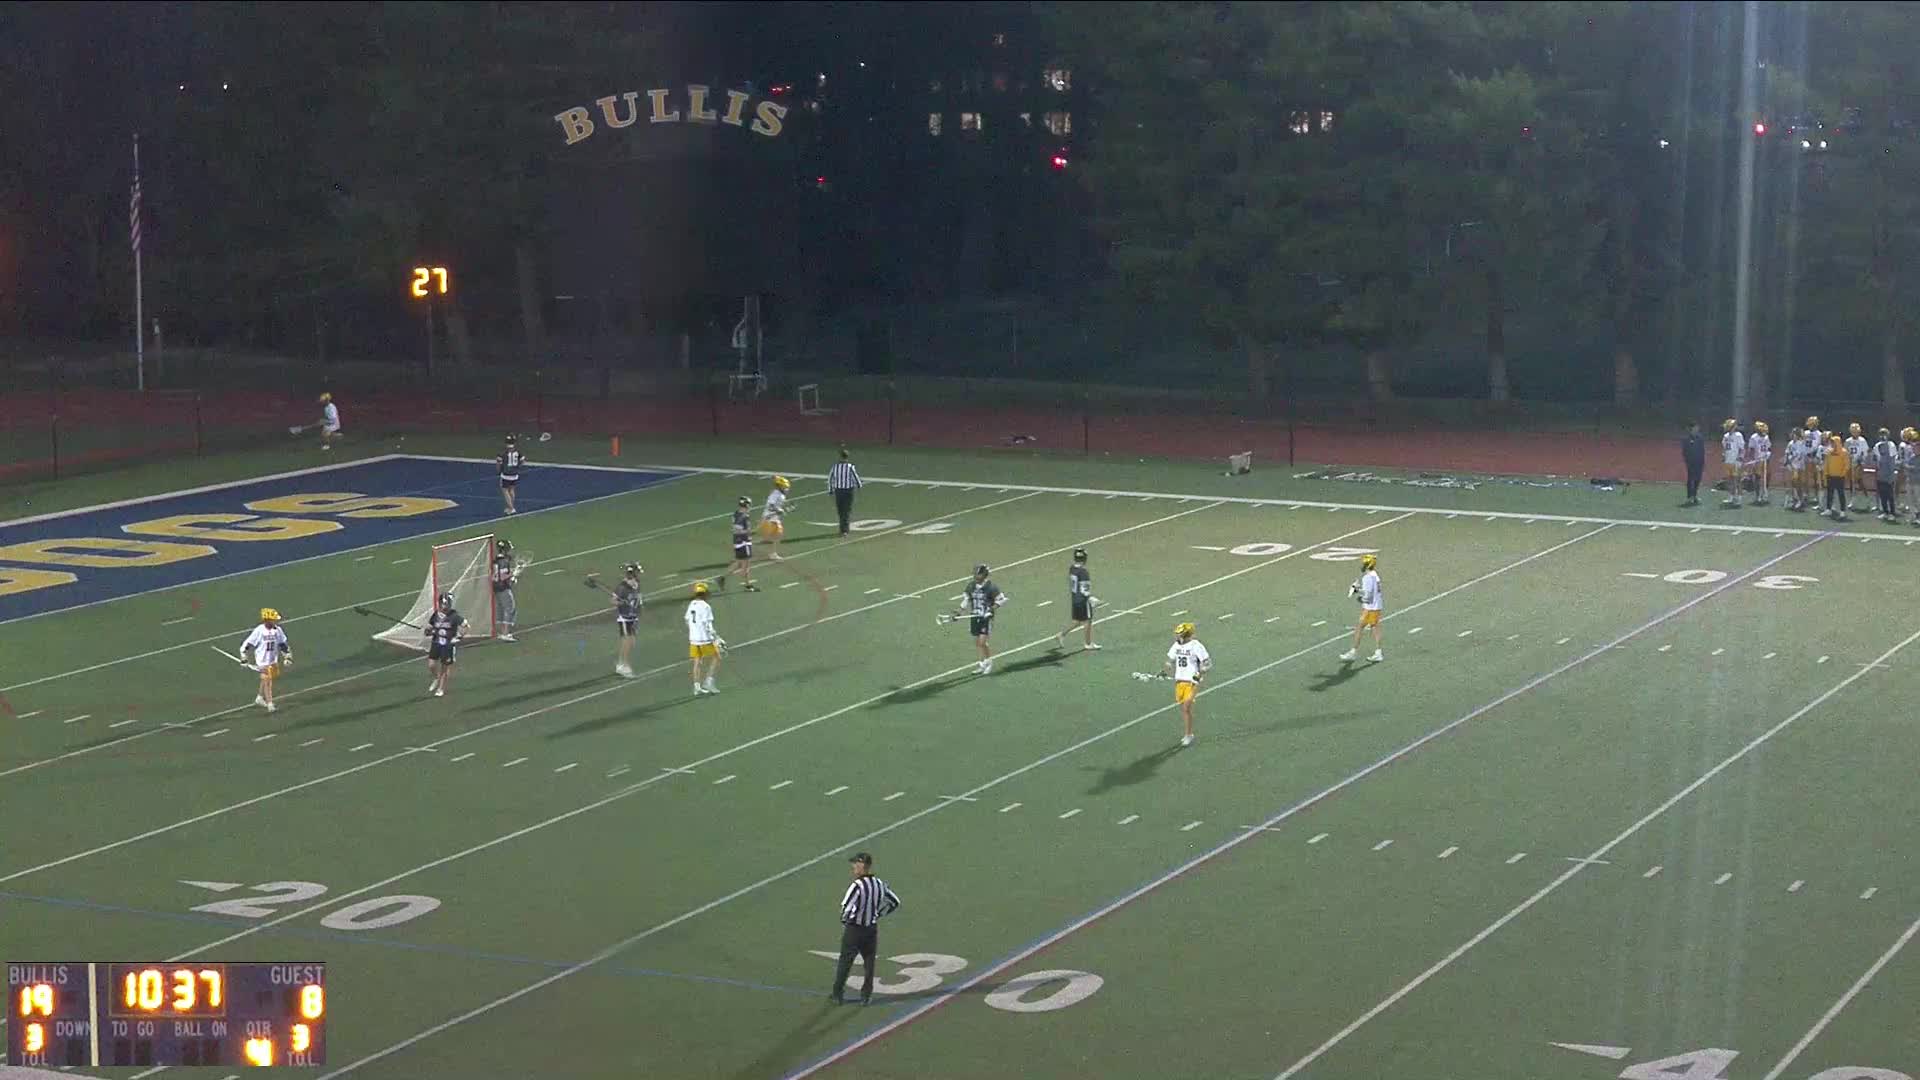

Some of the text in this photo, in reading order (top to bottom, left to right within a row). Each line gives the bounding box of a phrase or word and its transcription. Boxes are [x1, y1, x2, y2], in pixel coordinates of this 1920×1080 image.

[554, 85, 788, 145] BULLIS
[413, 268, 448, 297] 27
[190, 881, 441, 929] 20
[844, 953, 1103, 1012] 30
